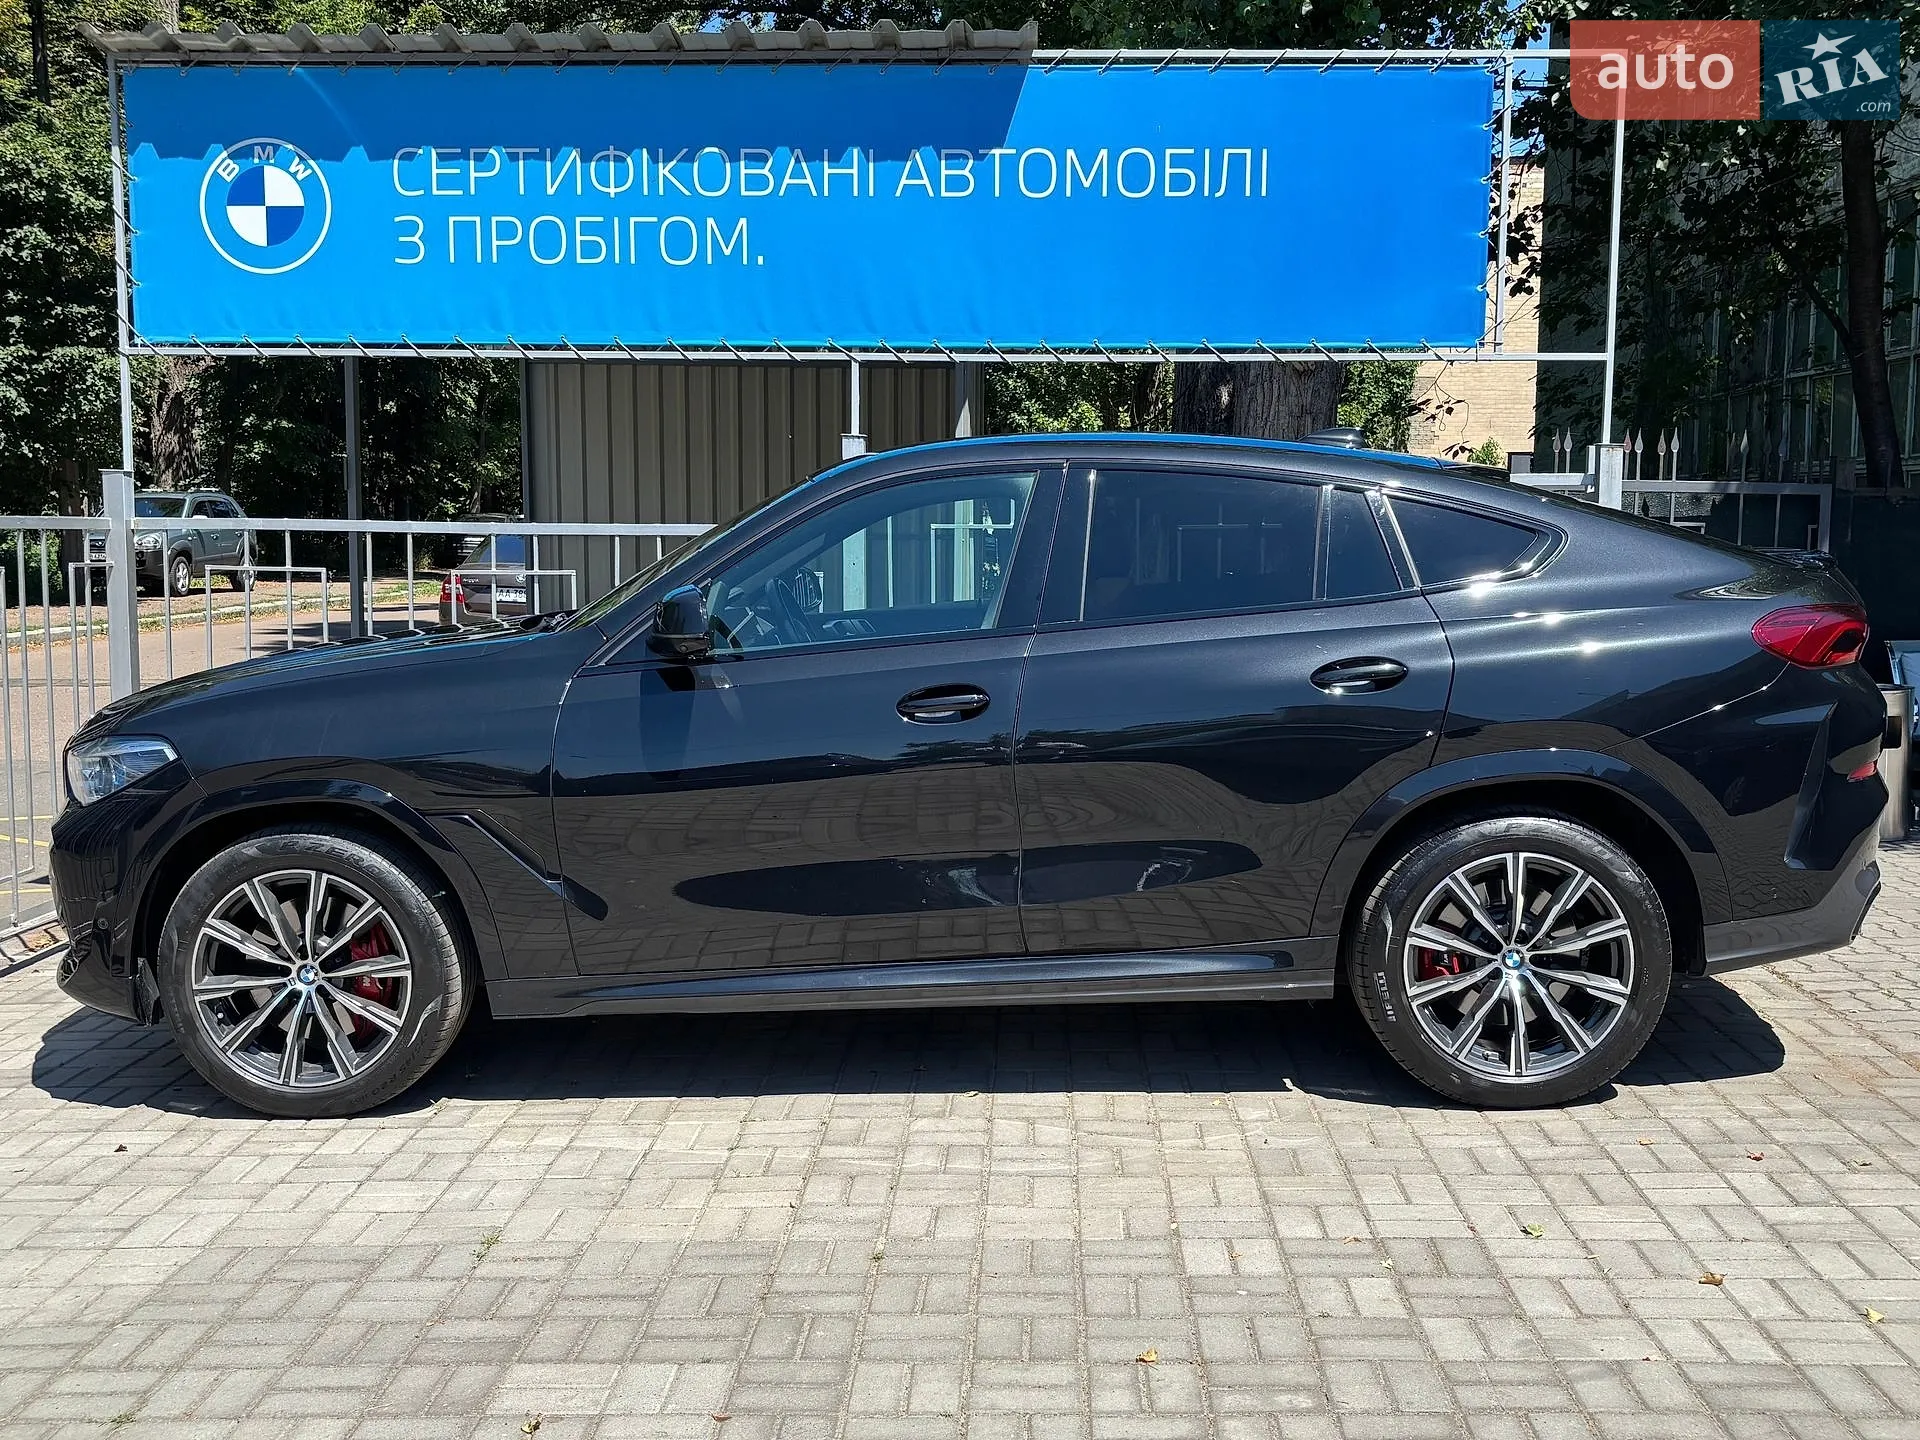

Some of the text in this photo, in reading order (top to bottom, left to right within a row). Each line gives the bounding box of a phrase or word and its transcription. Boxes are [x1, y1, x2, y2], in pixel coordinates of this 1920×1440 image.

[216, 145, 313, 183] BMW
[392, 145, 1269, 199] СЕРТИФІКОВАНІ АВТОМОБІЛІ
[393, 215, 765, 265] З ПРОБІГОМ.
